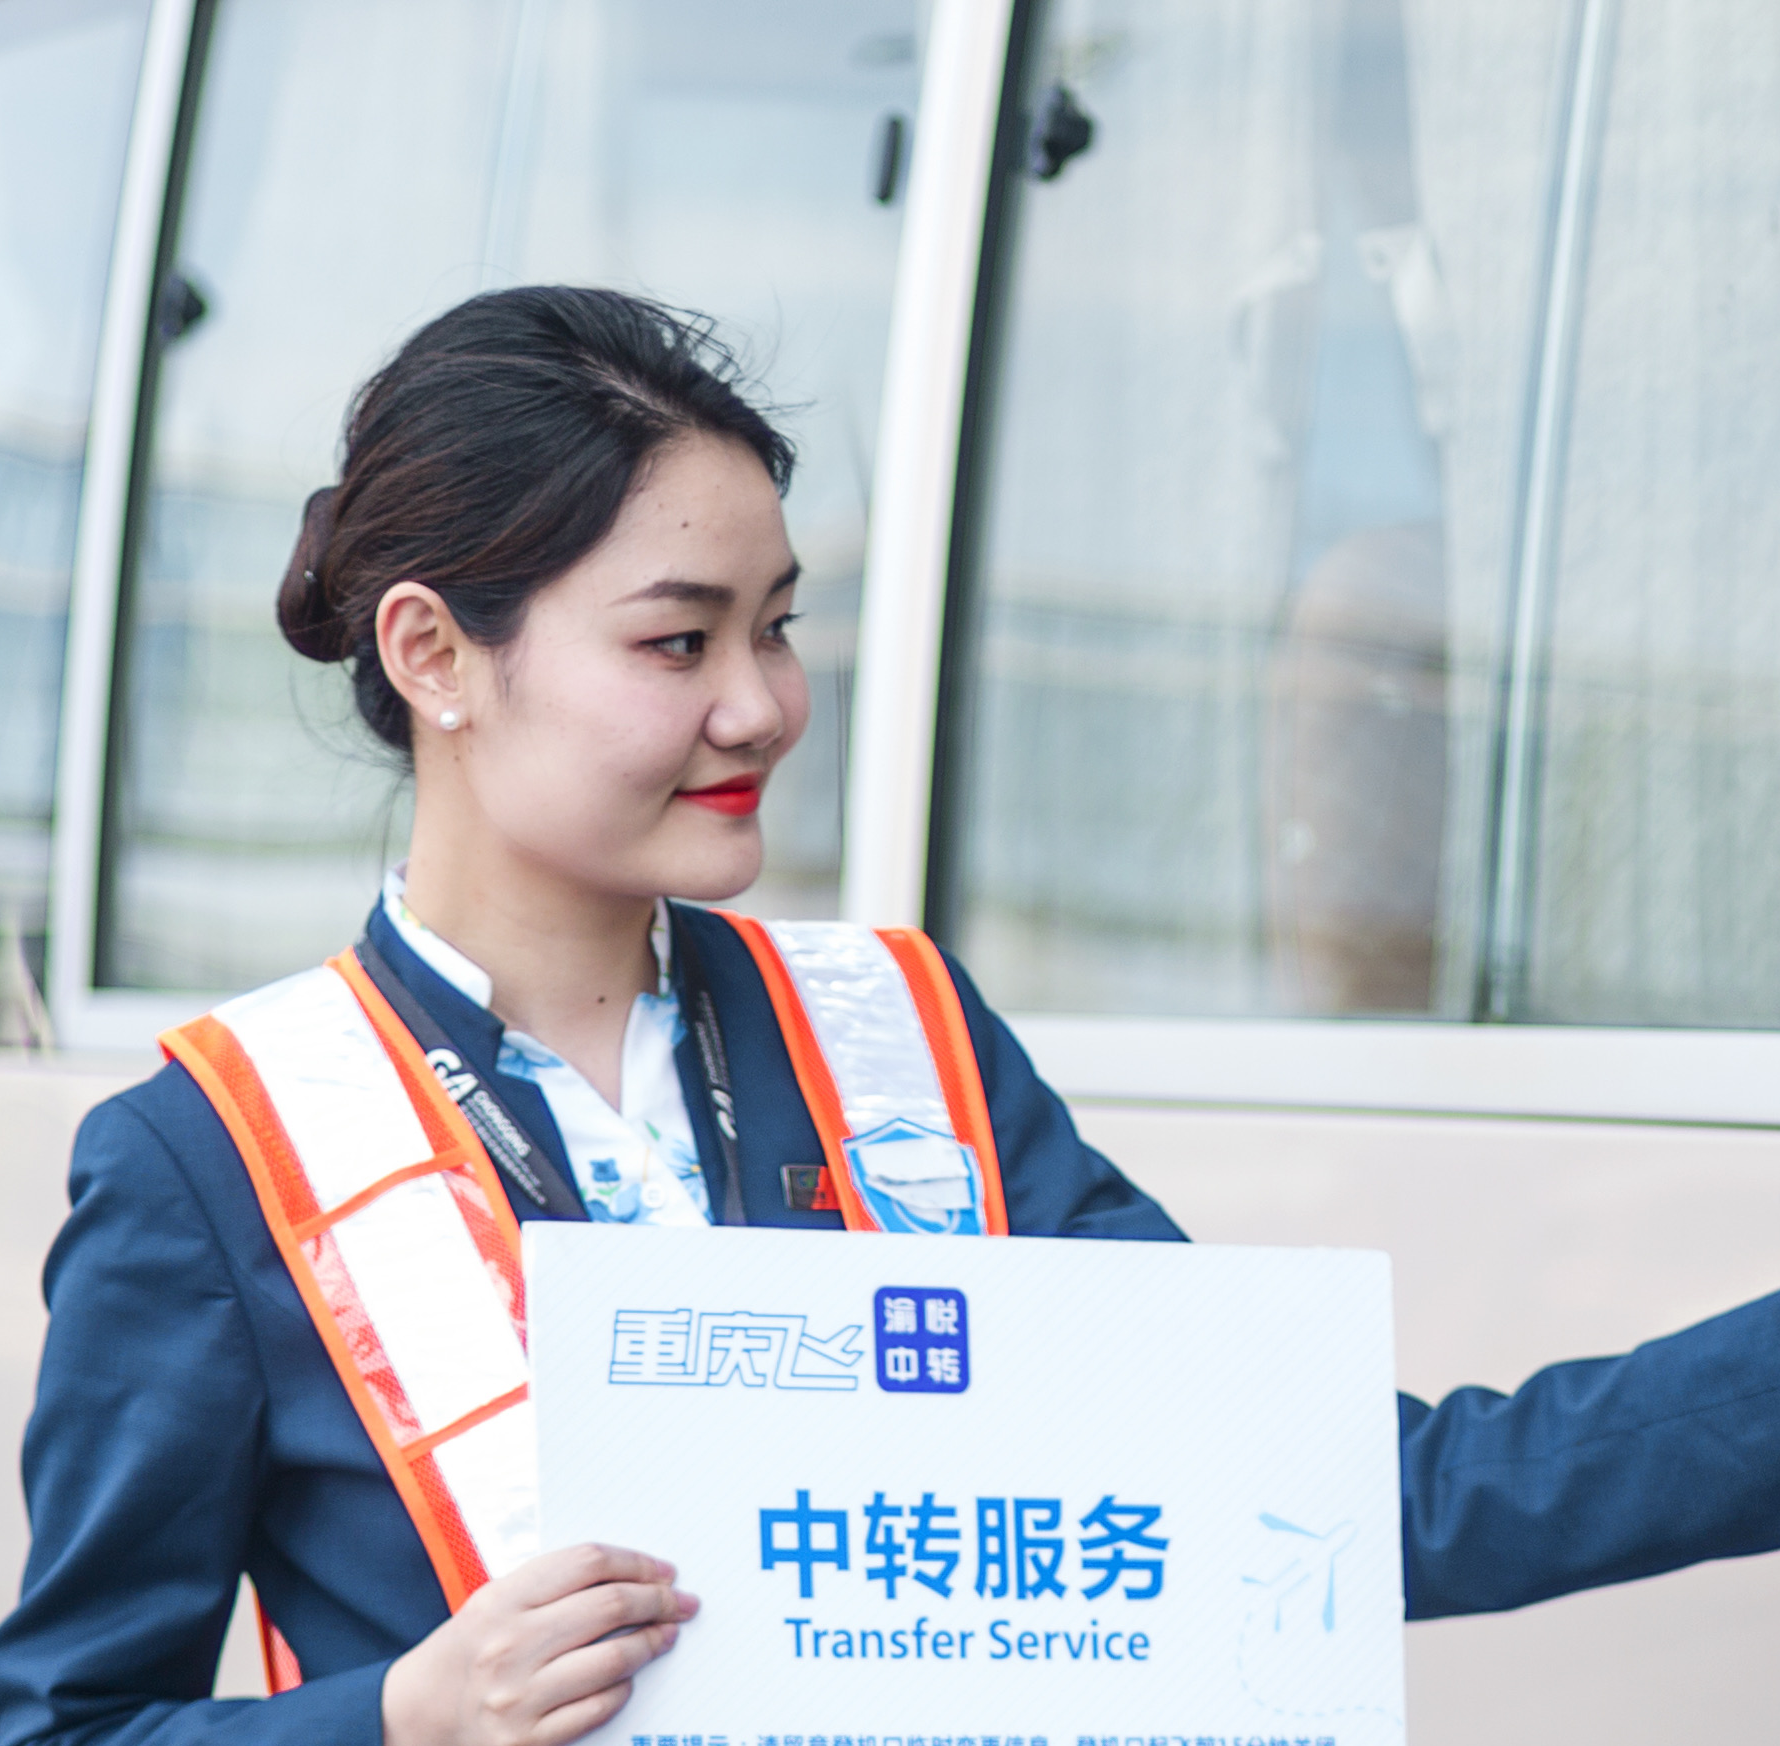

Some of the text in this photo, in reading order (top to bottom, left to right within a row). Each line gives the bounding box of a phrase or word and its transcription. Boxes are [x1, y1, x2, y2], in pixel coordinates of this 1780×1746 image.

[885, 1346, 962, 1385] 中转
[758, 1488, 1171, 1602] 中转服务
[784, 1615, 1151, 1661] Transfer Service
